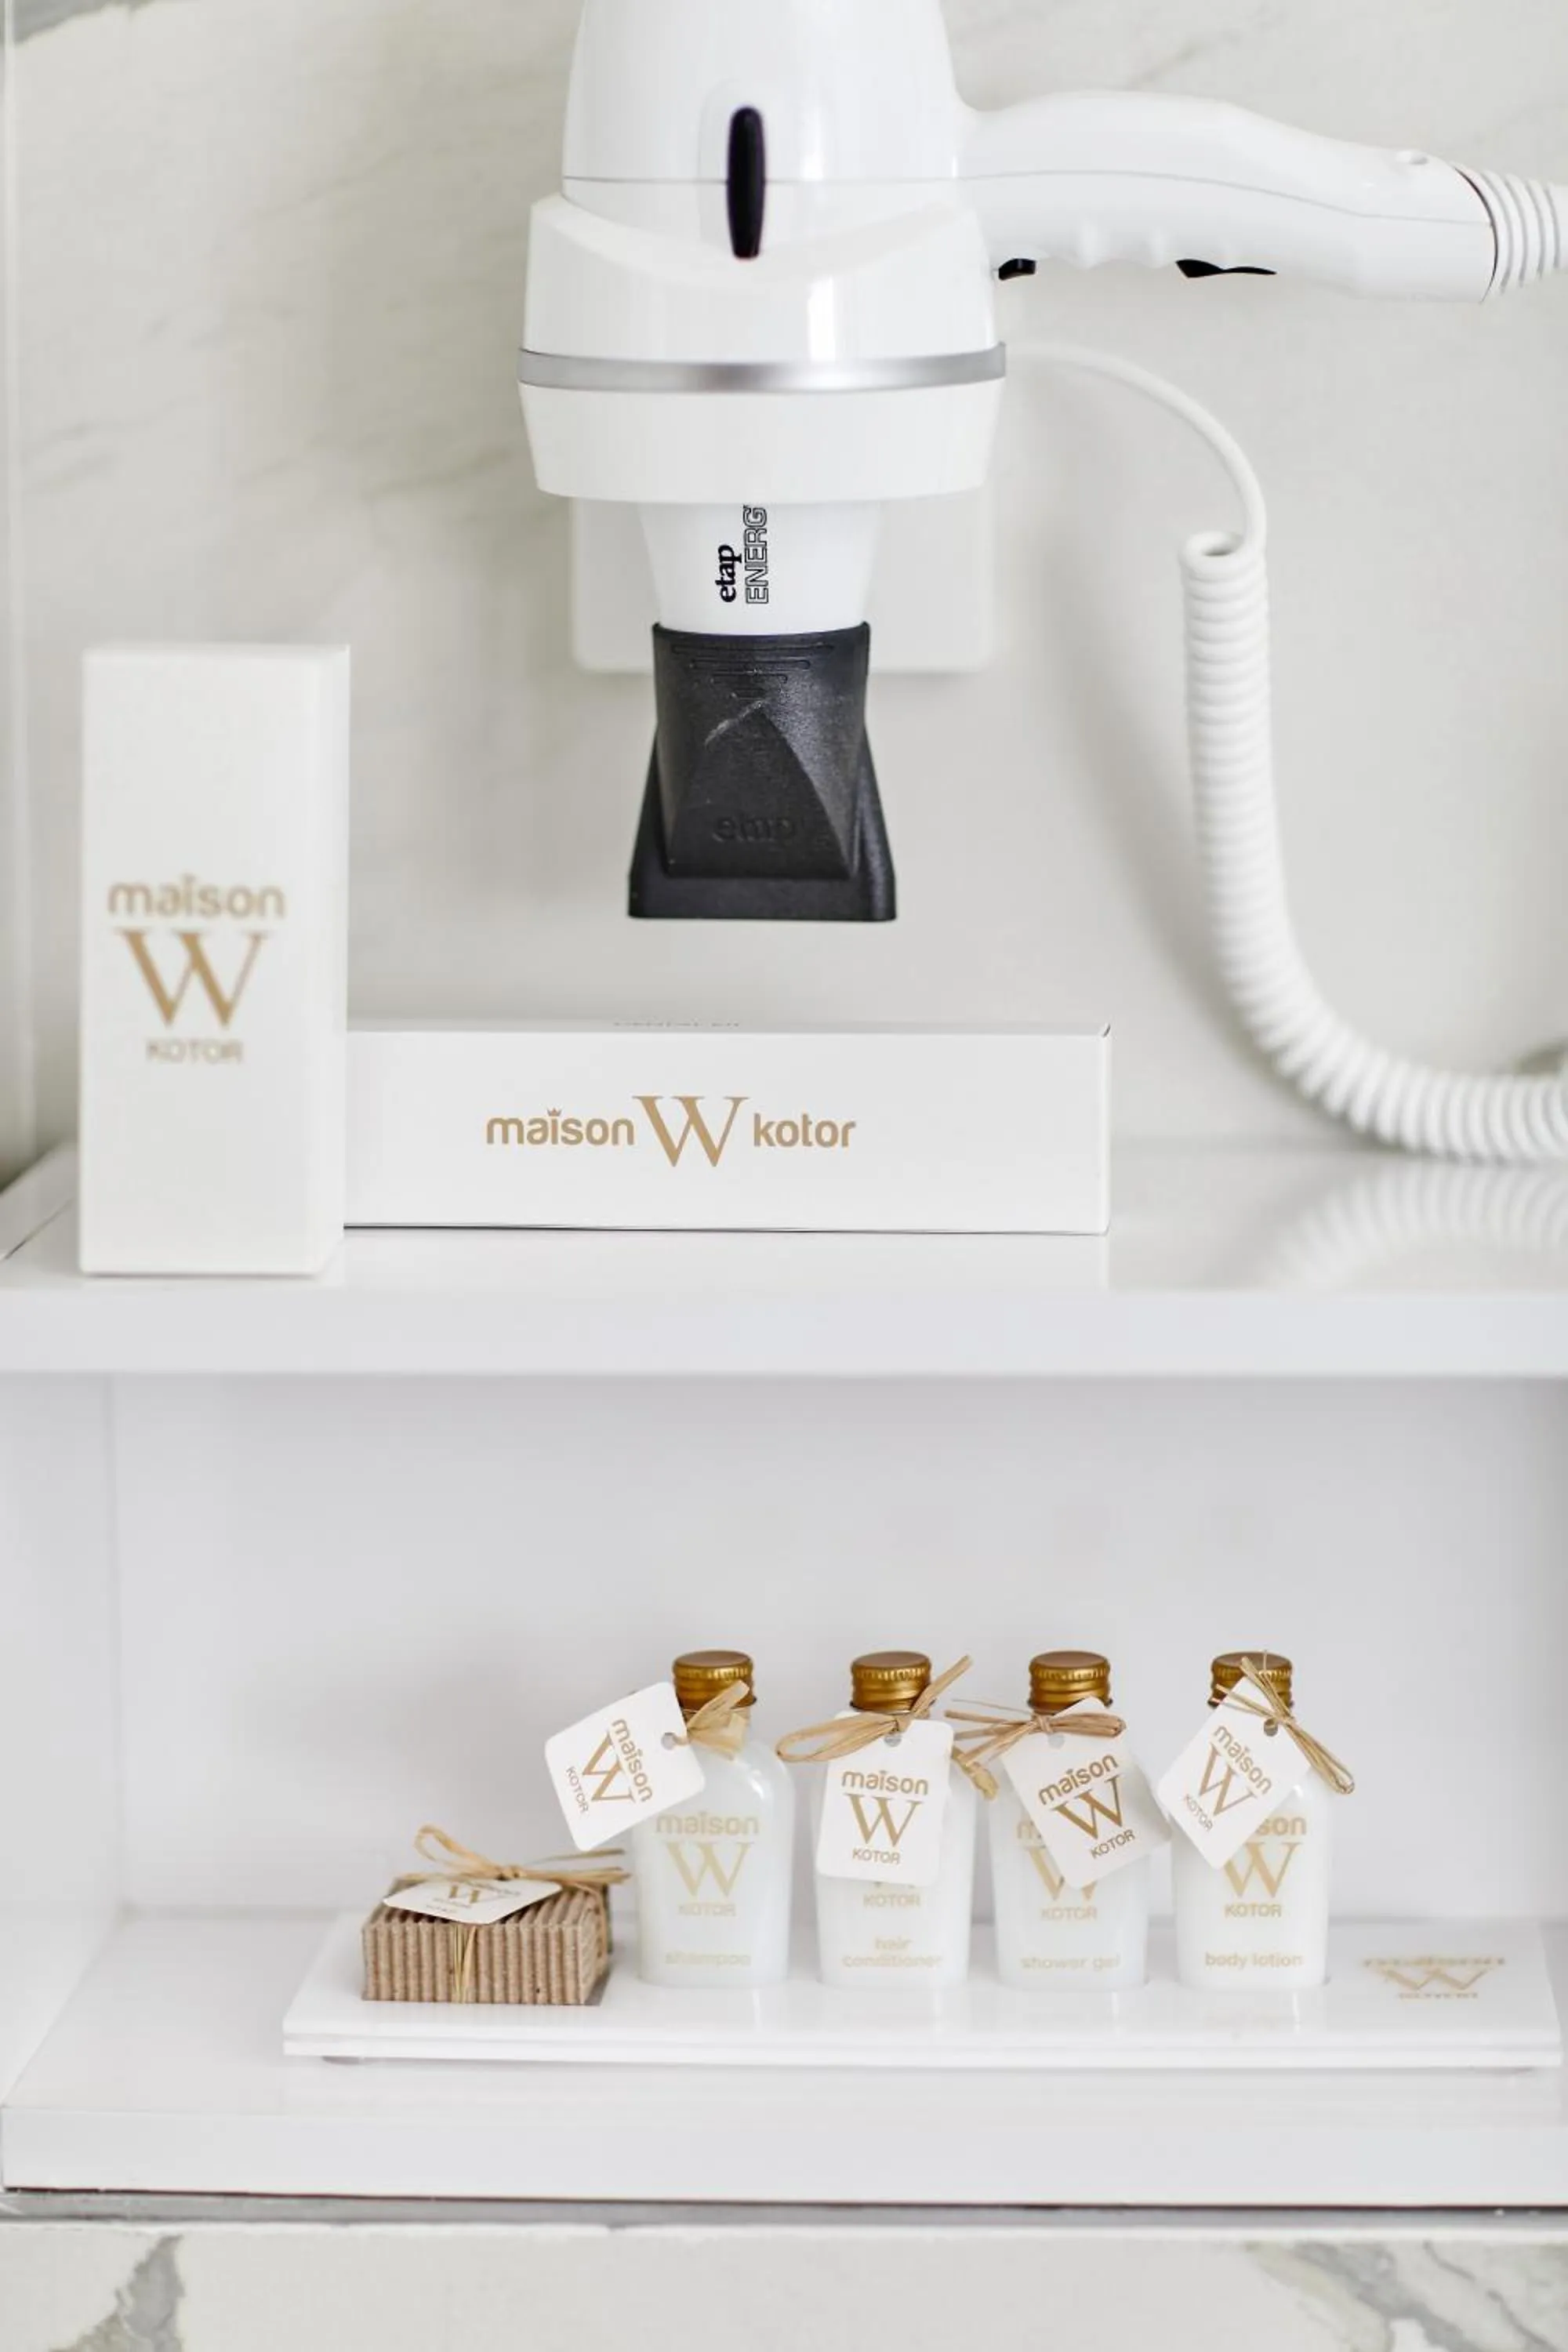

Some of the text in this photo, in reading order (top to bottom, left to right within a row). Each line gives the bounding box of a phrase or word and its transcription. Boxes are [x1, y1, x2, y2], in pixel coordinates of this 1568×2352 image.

[715, 544, 742, 602] etap
[743, 504, 770, 604] ENERG
[107, 872, 286, 917] maison
[114, 929, 272, 1028] W
[147, 1039, 243, 1063] KOTOR
[486, 1095, 856, 1167] maison W kotor
[582, 1730, 637, 1804] W
[612, 1718, 653, 1802] maison
[841, 1769, 928, 1795] maison
[1038, 1753, 1119, 1805] maison
[1198, 1742, 1257, 1817] W
[1213, 1725, 1272, 1795] maison
[566, 1766, 589, 1814] KOTOR
[1051, 1774, 1124, 1840] W
[1182, 1794, 1214, 1832] KOTOR
[655, 1810, 760, 1835] maison
[844, 1793, 924, 1846] W
[852, 1848, 901, 1864] KOTOR
[1090, 1829, 1136, 1859] KOTOR
[666, 1841, 754, 1898] W
[862, 1893, 921, 1907] KOTOR
[1040, 1907, 1098, 1921] KOTOR
[1224, 1904, 1283, 1918] KOTOR
[1022, 1955, 1087, 1969] shower
[1204, 1952, 1303, 1970] body lotion
